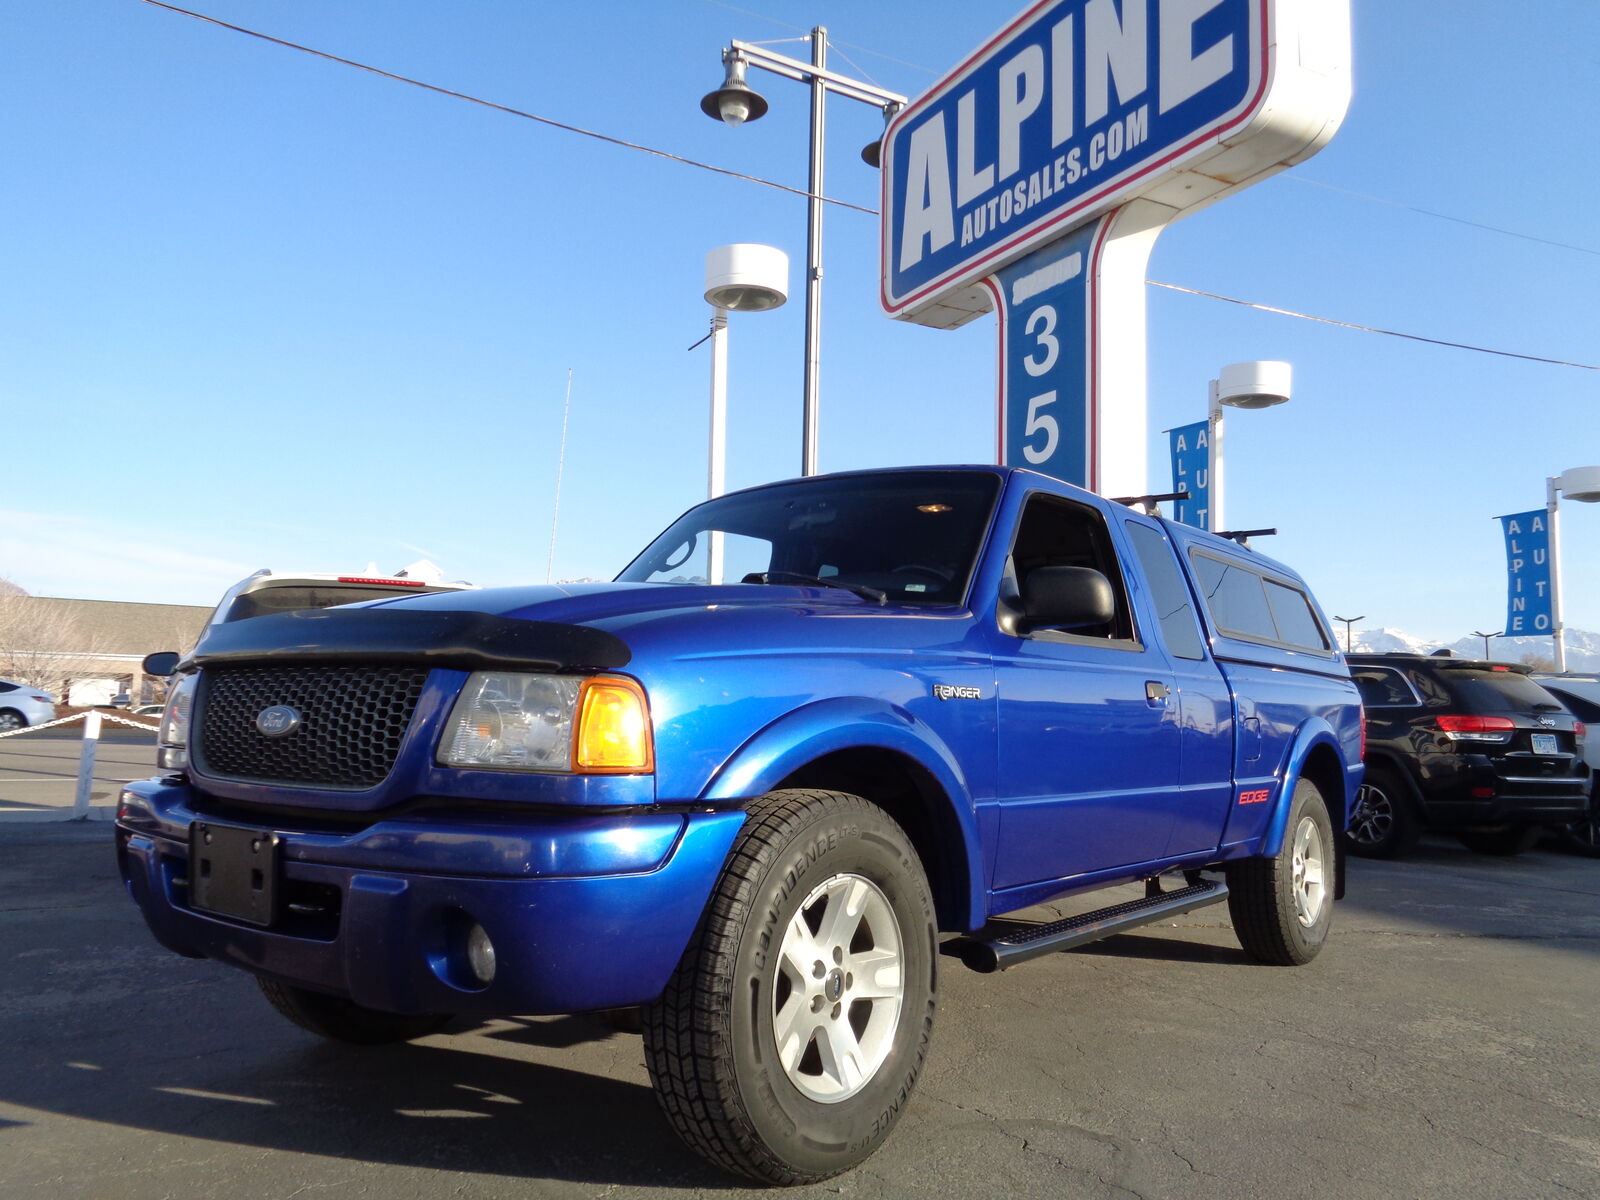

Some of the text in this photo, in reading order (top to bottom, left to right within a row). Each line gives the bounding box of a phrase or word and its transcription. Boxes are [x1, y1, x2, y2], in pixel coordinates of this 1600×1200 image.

[900, 0, 1233, 273] ALPINE
[961, 103, 1148, 248] AUTOSALES.COM
[1508, 519, 1525, 631] ALPINE
[1532, 516, 1549, 630] AUTO
[933, 684, 981, 700] RANGER
[1540, 716, 1556, 727] Jeep
[1238, 789, 1270, 805] EDGE
[754, 833, 837, 970] CONFIDENCE
